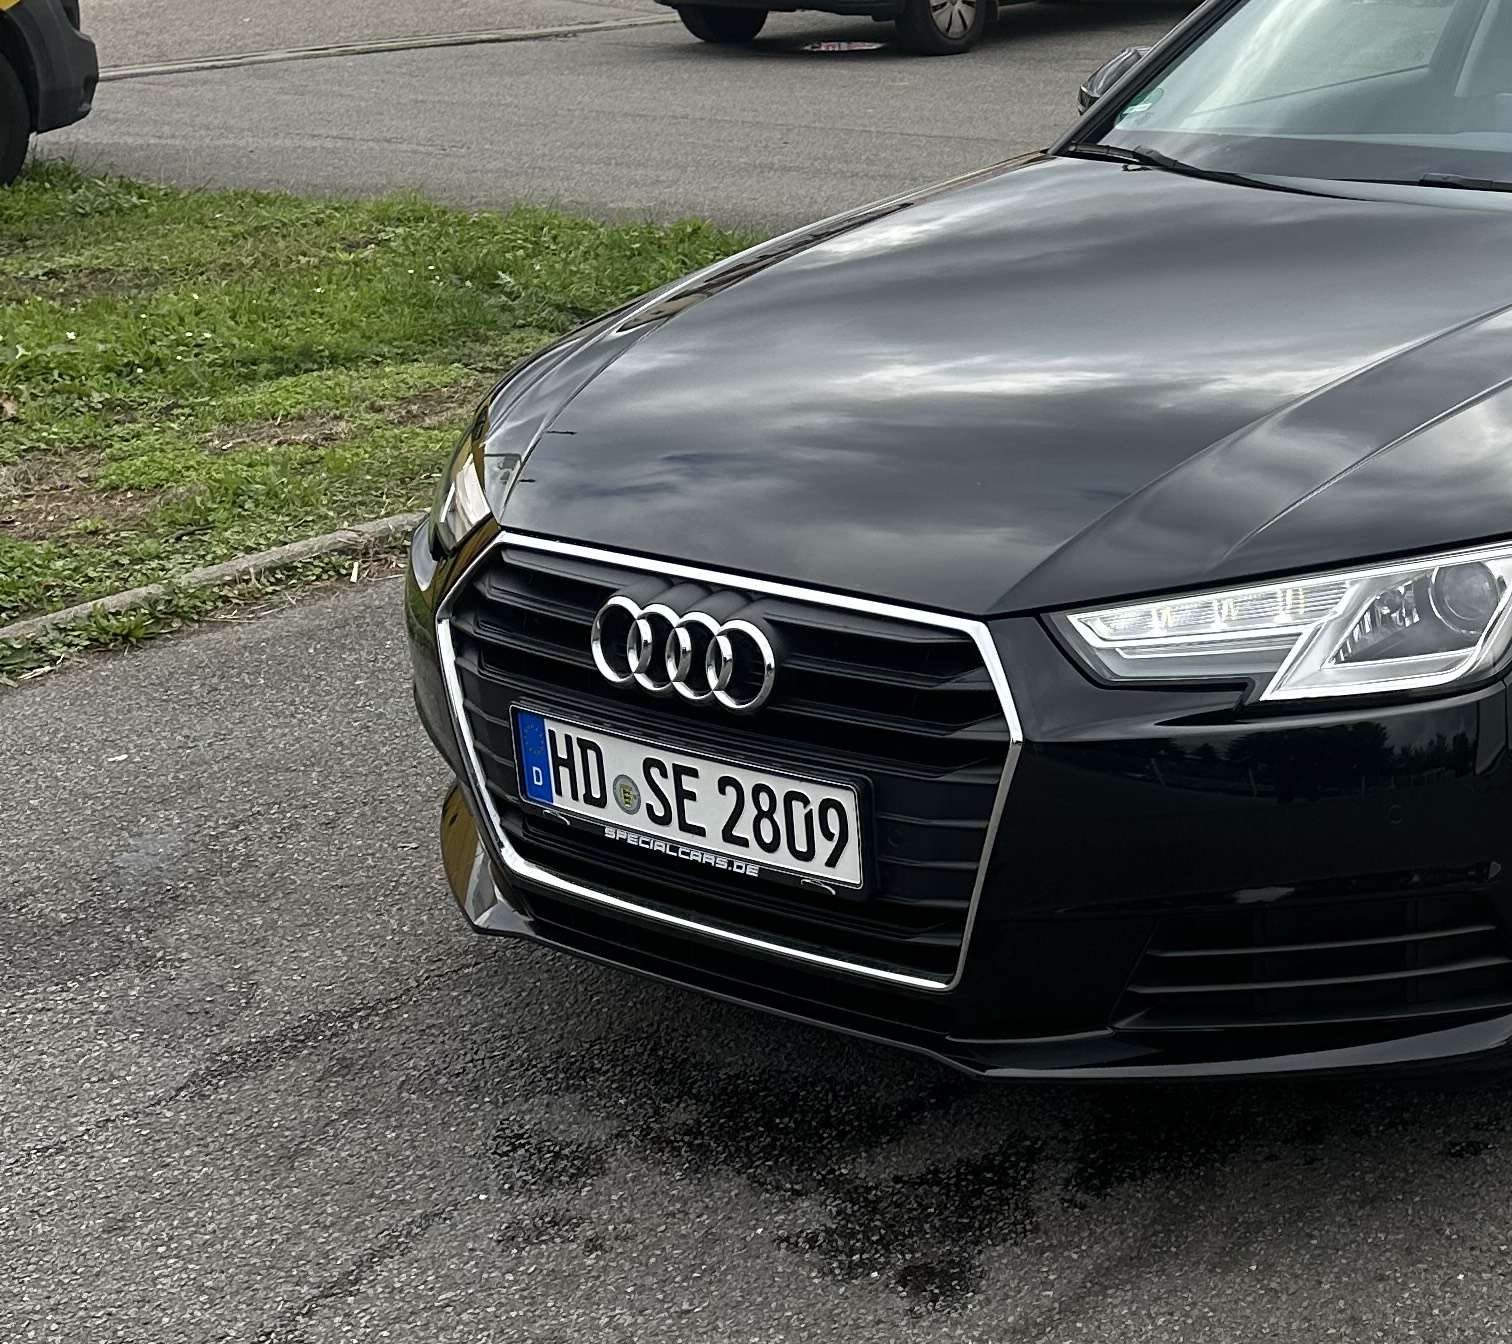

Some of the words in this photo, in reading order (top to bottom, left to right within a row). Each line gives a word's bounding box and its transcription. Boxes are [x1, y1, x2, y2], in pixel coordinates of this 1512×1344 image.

[533, 766, 545, 788] D
[548, 728, 608, 809] HD
[642, 757, 707, 838] SE
[717, 775, 850, 869] 2809
[604, 825, 760, 878] SPECIALCARS.DE
